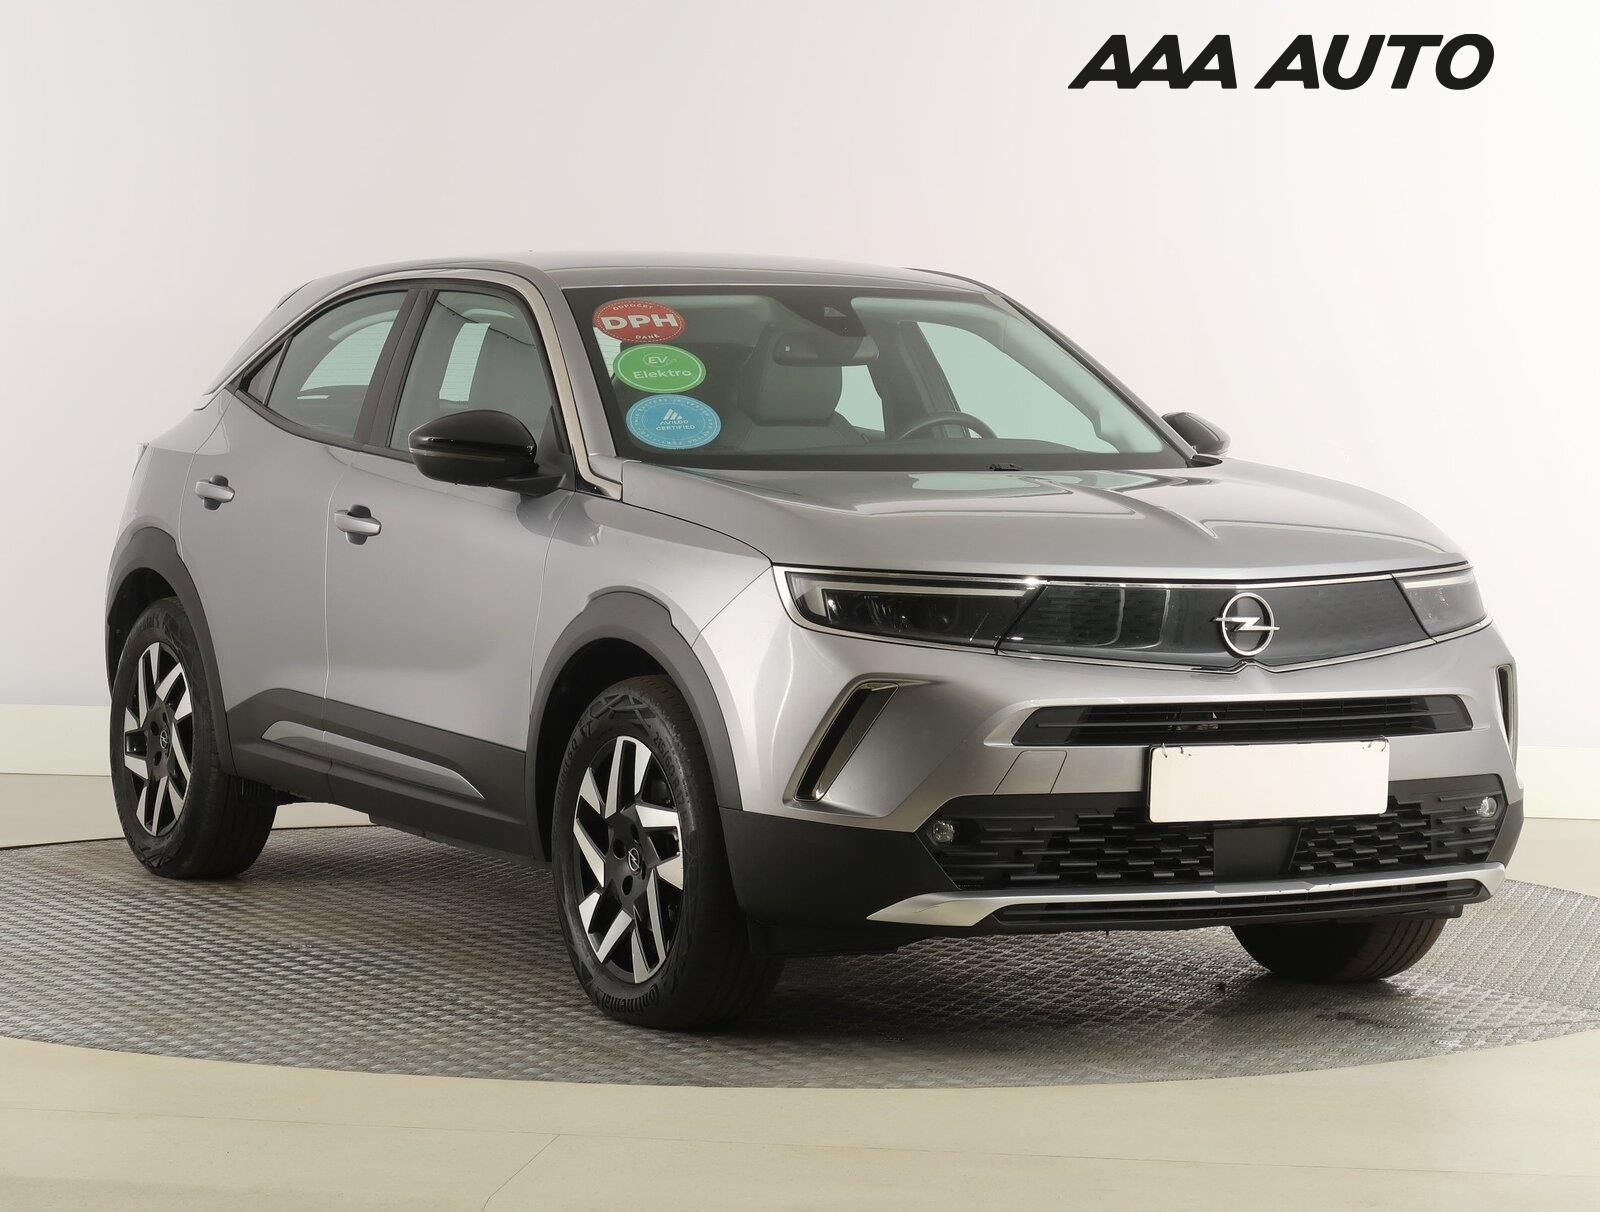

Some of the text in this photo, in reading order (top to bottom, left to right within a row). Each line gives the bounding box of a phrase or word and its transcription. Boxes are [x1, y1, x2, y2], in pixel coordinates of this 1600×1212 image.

[600, 313, 679, 330] DPH
[648, 356, 668, 364] EV
[633, 370, 692, 379] Elektro
